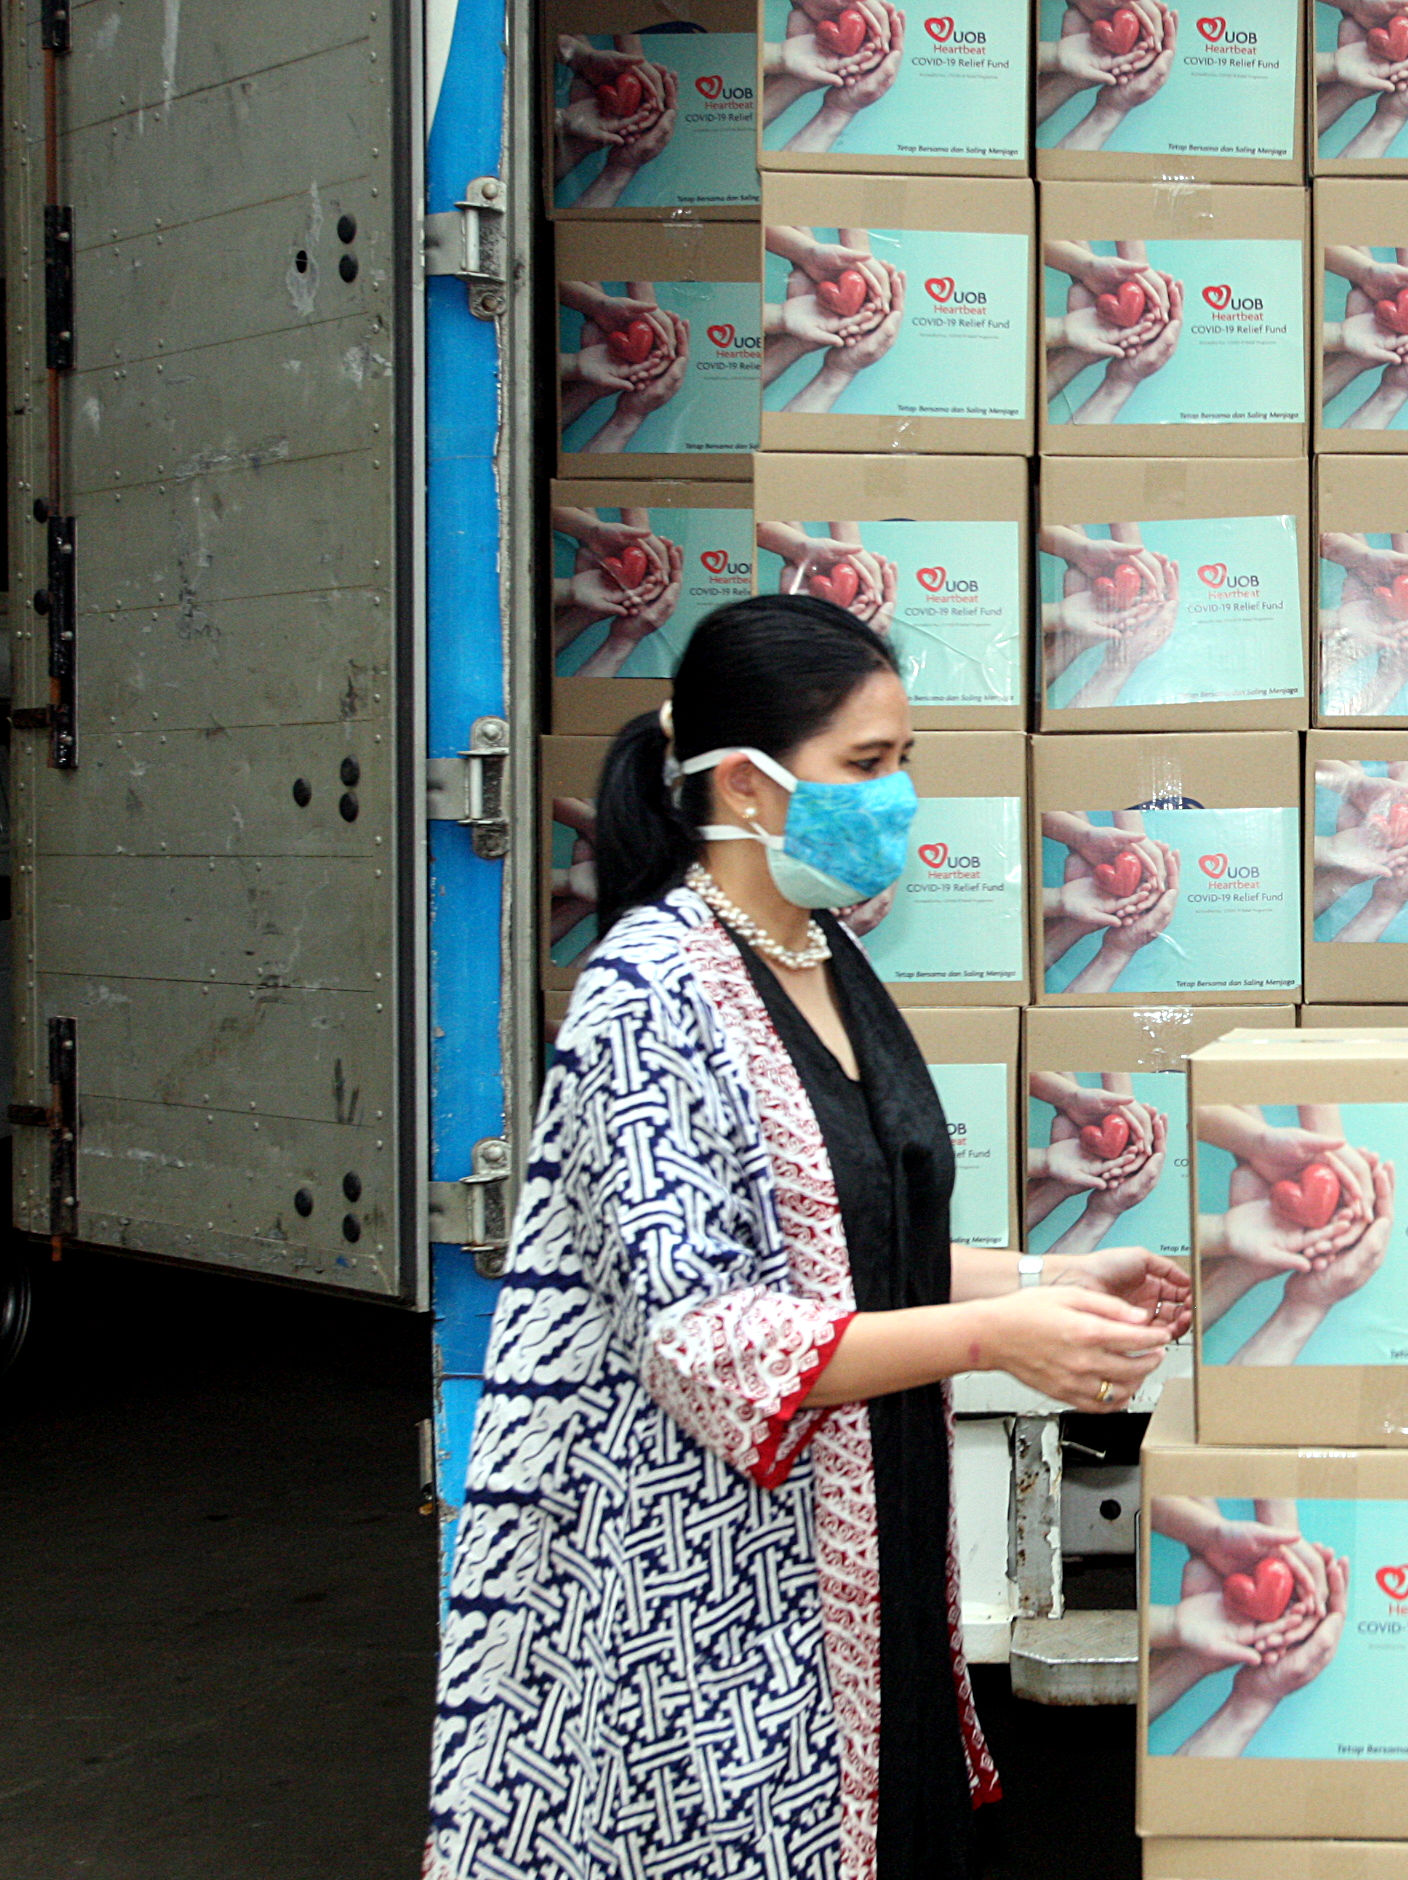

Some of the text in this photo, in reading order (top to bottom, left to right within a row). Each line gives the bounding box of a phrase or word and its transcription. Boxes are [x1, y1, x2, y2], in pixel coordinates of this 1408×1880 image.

[953, 31, 986, 44] UOB
[1224, 31, 1257, 44] UOB
[933, 44, 986, 55] Heartbeat
[1205, 44, 1257, 55] Heartbeat
[911, 57, 1010, 69] COVID-19 Relief Fund
[1183, 56, 1280, 69] COVID-19 Relief Fund
[722, 87, 753, 99] UOB
[704, 100, 754, 110] Heartbeat
[685, 112, 753, 122] COVID-19 Relief
[953, 291, 987, 304] UOB
[934, 304, 986, 315] Heartbeat
[1231, 298, 1264, 310] UOB
[1212, 311, 1264, 321] Heartbeat
[911, 317, 1010, 329] COVID-19 Relief Fund
[1190, 325, 1287, 334] COVID-19 Relief Fund
[716, 349, 762, 358] Heartbea
[696, 362, 762, 370] COVID-19 Relie
[945, 580, 978, 592] UOB
[1226, 574, 1260, 588] UOB
[689, 588, 730, 596] COVID-19
[926, 594, 979, 603] Heartbeat
[904, 607, 1002, 616] COVID-19 Relief Fund
[1233, 601, 1260, 612] Relief
[1262, 600, 1285, 610] Fund
[947, 856, 981, 868] UOB
[928, 870, 981, 880] Heartbeat
[1227, 866, 1260, 879] UOB
[906, 883, 1005, 893] COVID-19 Relief Fund
[1208, 880, 1260, 890] Heartbeat
[1187, 892, 1283, 903] COVID-19 Relief Fund
[946, 1123, 967, 1136] OB
[968, 1149, 990, 1158] Fund
